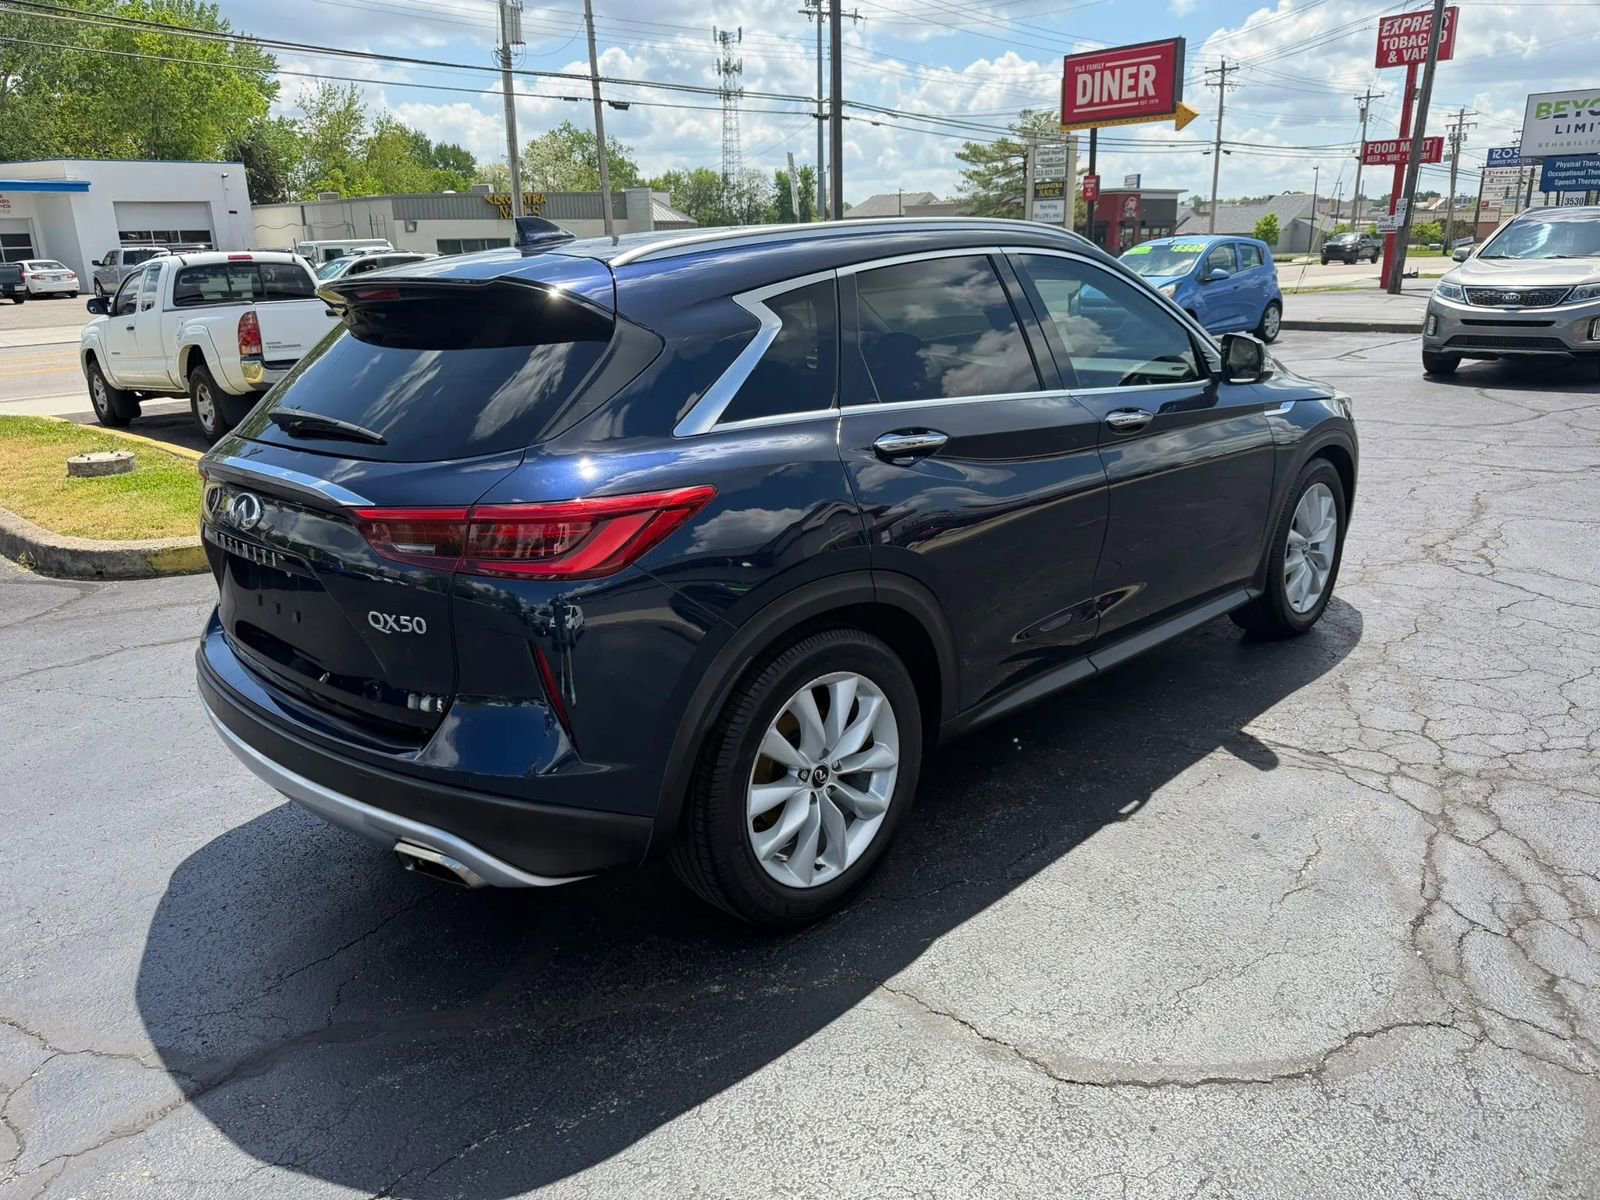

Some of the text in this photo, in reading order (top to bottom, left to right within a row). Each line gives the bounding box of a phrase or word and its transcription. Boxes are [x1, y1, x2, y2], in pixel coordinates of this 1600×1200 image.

[1381, 11, 1452, 36] EXPRES
[1381, 31, 1448, 51] TOBACO
[1387, 47, 1429, 64] & VAP
[1086, 62, 1105, 71] FAMILY
[1076, 64, 1156, 106] DINER
[1555, 123, 1600, 135] LIMI
[1367, 142, 1396, 154] FOOD
[1399, 140, 1433, 152] MT
[1366, 155, 1381, 163] BEER
[1492, 148, 1520, 159] ROS
[1556, 160, 1600, 169] Physical Thera
[1548, 169, 1586, 177] Occupational
[484, 193, 547, 205] CLEOTRA
[1039, 189, 1060, 197] NAILS
[1565, 197, 1585, 206] 3530
[367, 610, 427, 634] QX50
